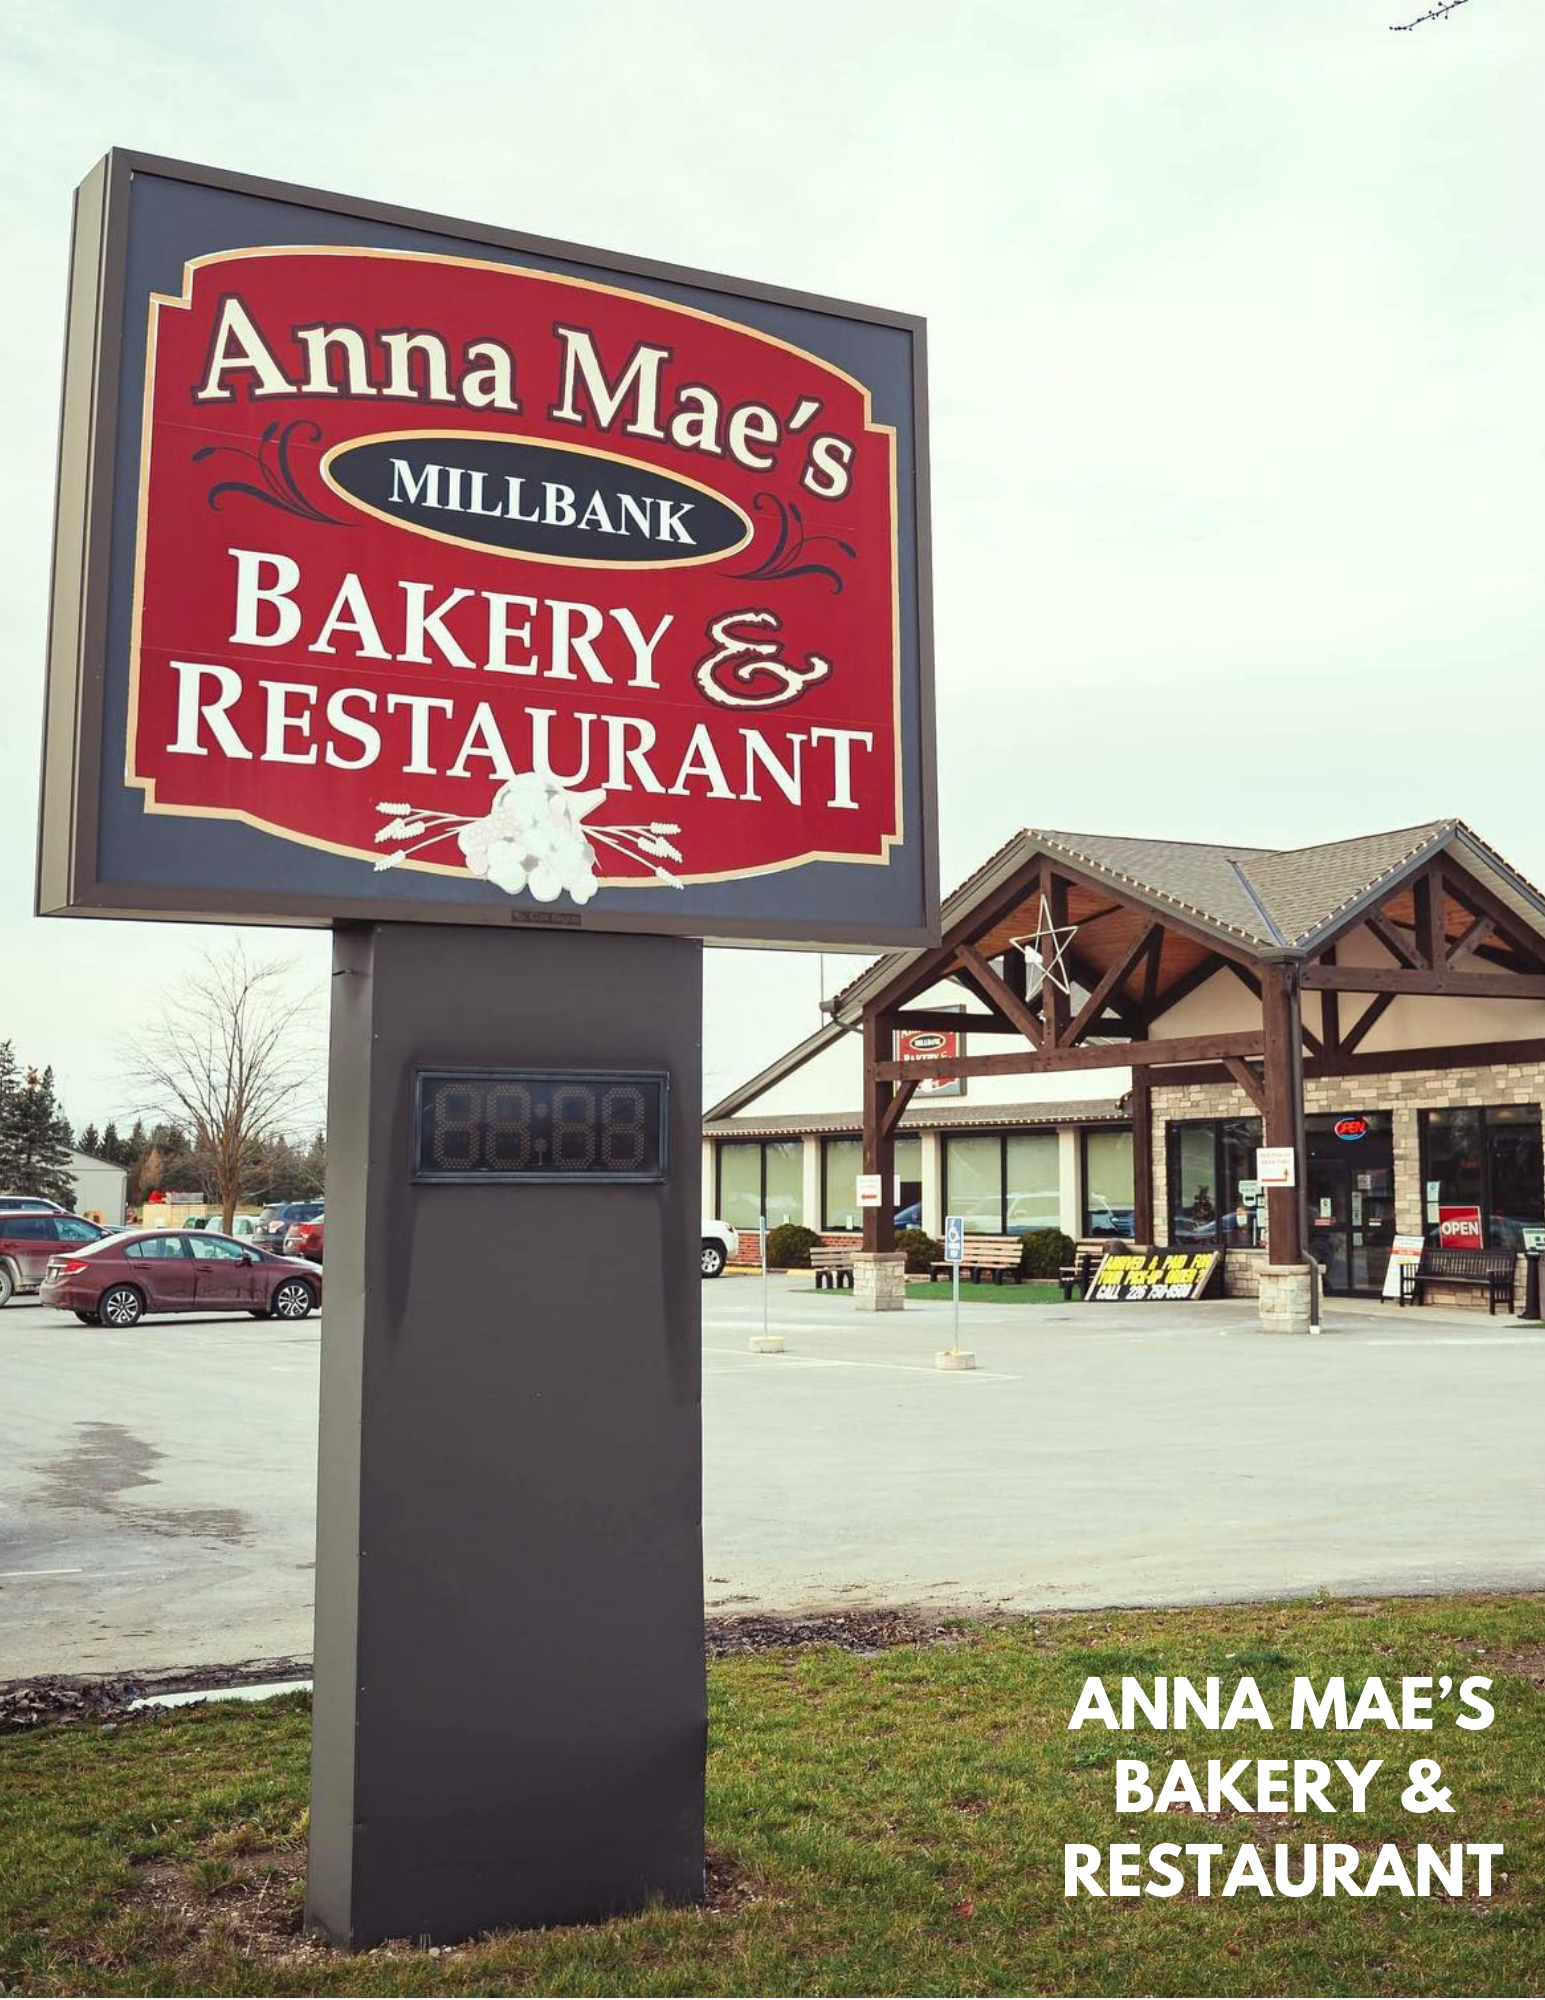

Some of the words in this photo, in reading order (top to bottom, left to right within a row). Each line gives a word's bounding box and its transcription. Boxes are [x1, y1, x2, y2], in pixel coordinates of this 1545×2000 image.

[196, 295, 520, 413] Anna
[552, 325, 852, 499] Mae's
[388, 457, 698, 546] MILLBANK
[228, 547, 676, 690] BAKERY
[694, 608, 832, 710] &
[166, 660, 875, 811] RESTAURANT
[1336, 1120, 1365, 1134] OPEN
[1441, 1220, 1479, 1236] OPEN
[1103, 1255, 1146, 1270] ARRIVED
[1161, 1254, 1188, 1271] PAID
[1189, 1253, 1213, 1269] FOR
[1097, 1270, 1125, 1286] YOUR
[1123, 1269, 1164, 1286] PICK-UP
[1096, 1285, 1121, 1299] CALL
[1125, 1284, 1148, 1300] 226
